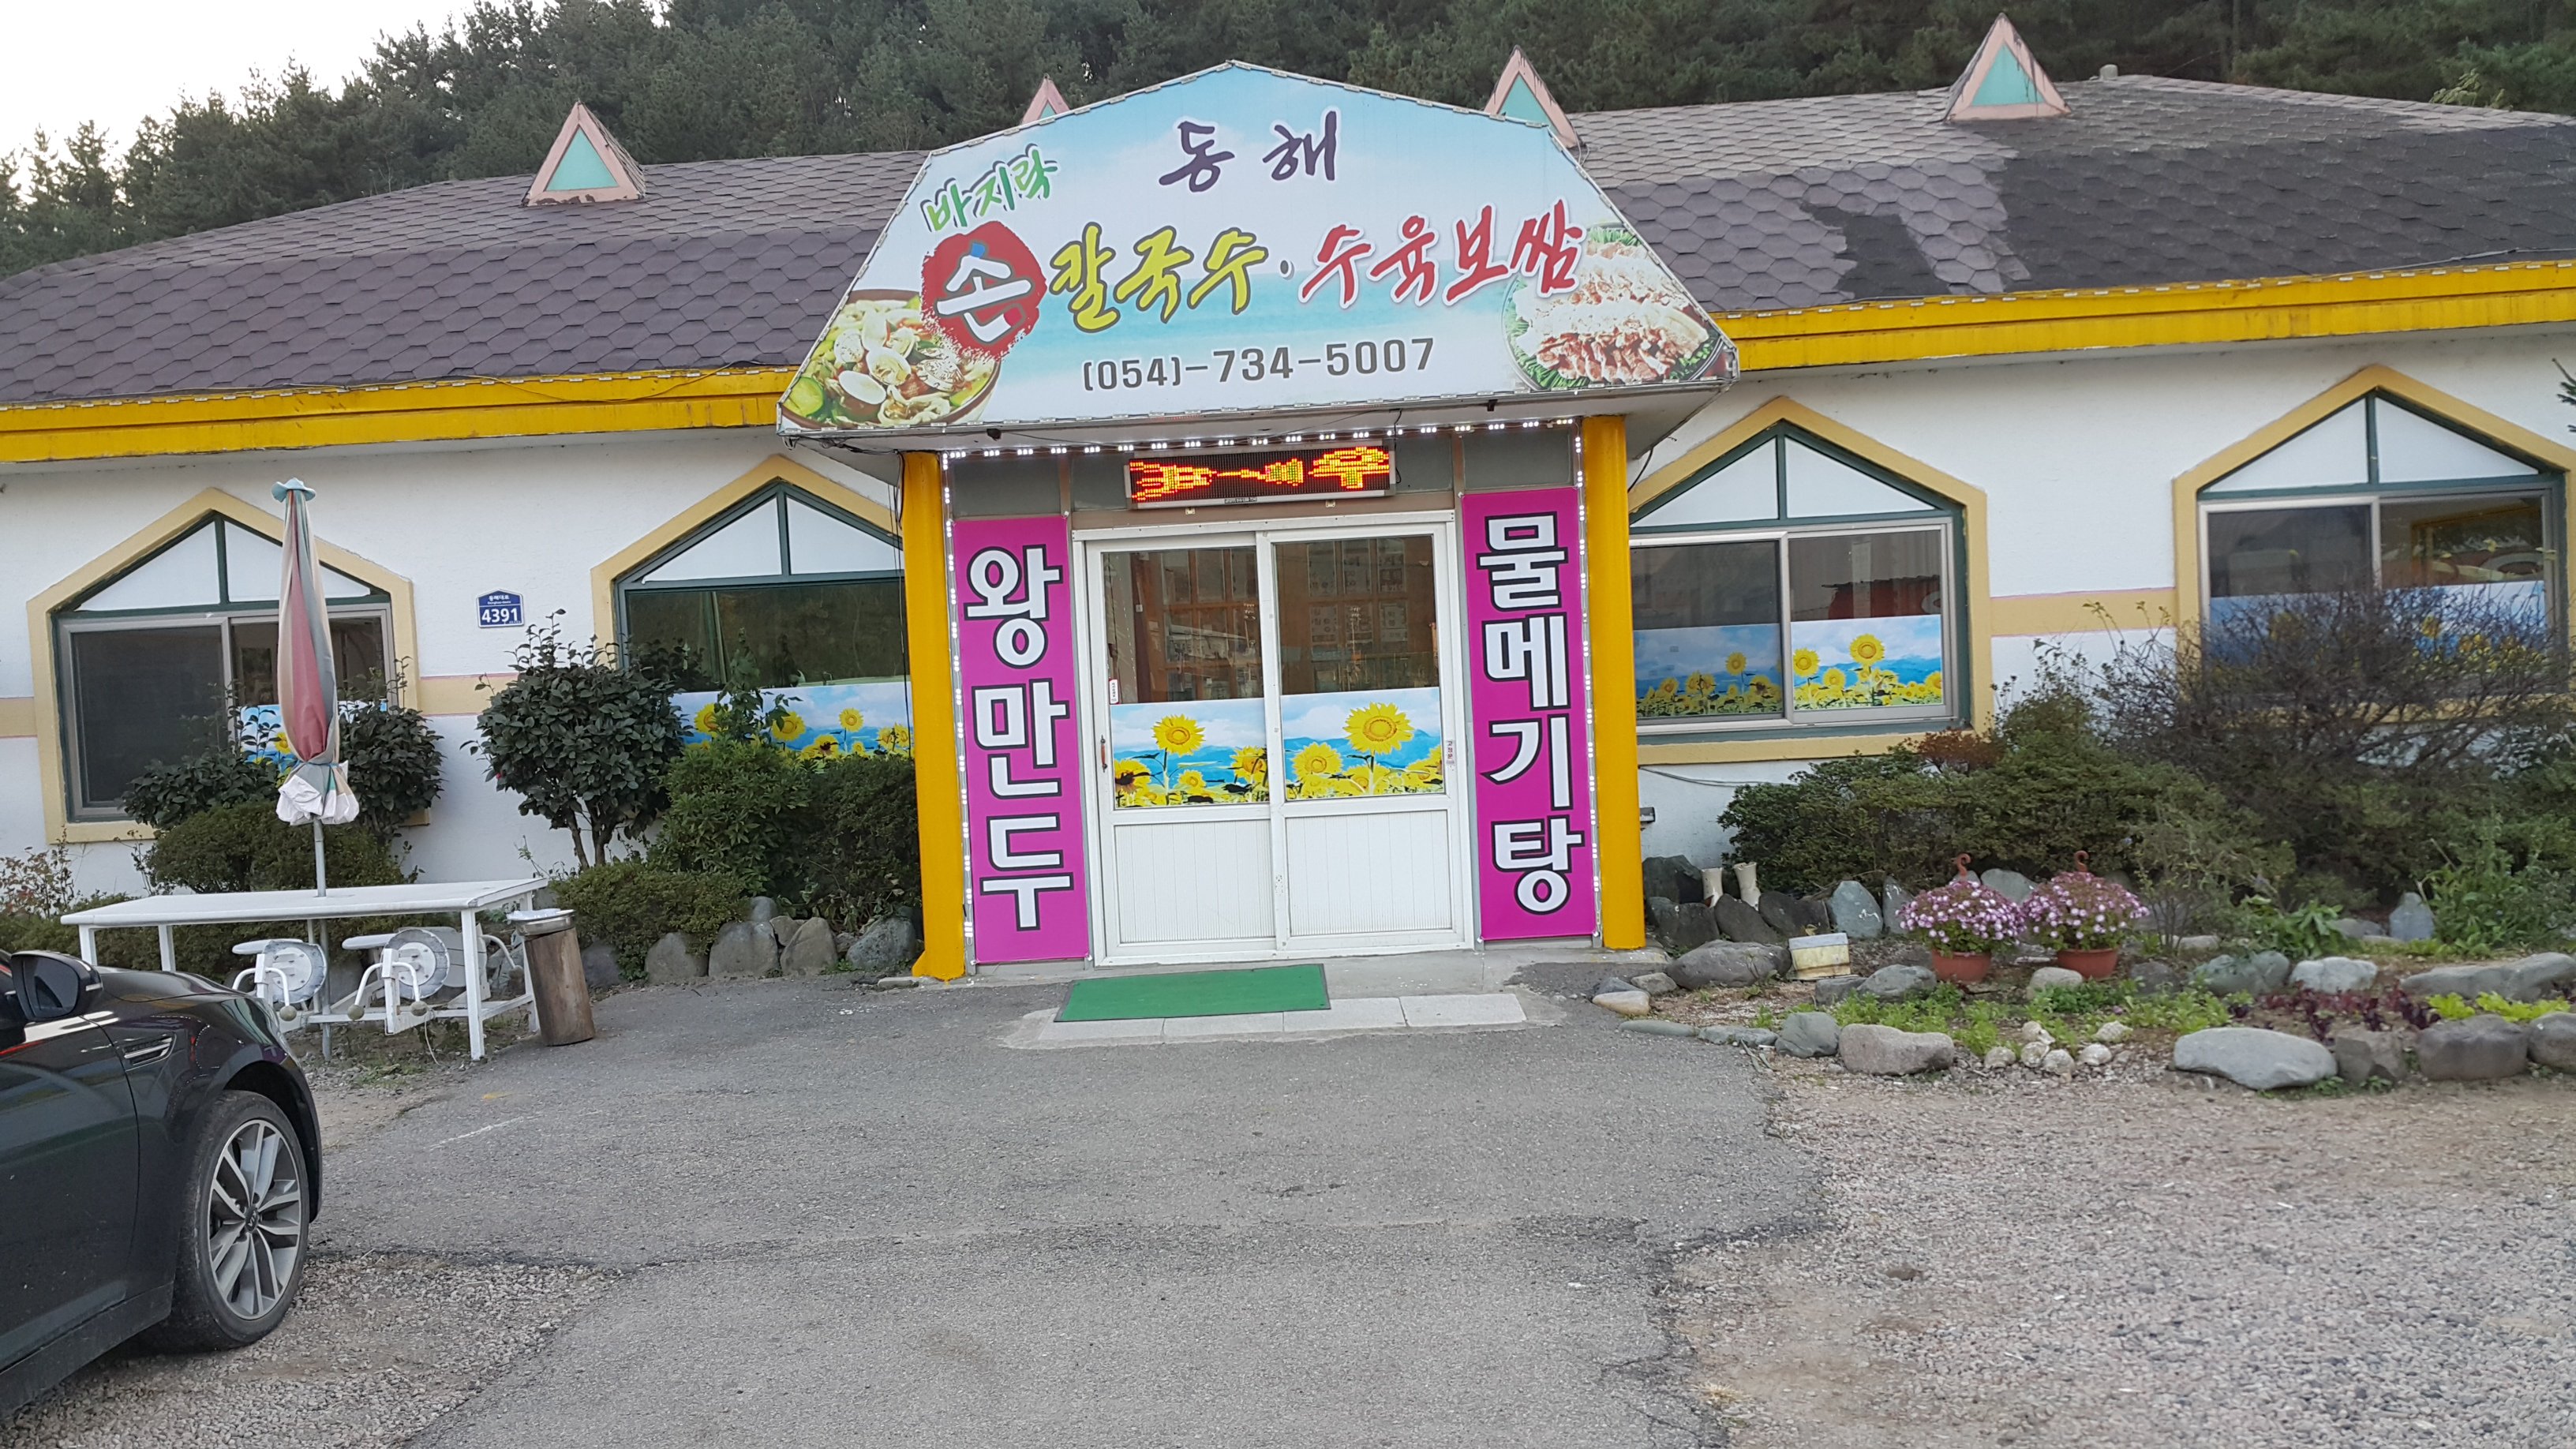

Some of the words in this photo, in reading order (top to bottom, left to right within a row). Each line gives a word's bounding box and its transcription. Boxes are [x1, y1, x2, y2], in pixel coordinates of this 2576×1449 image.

[920, 143, 1058, 232] 바지락
[1050, 222, 1269, 333] 칼국수
[1299, 197, 1586, 306] 수육보쌈
[1082, 337, 1435, 391] (054)-734-5007
[481, 607, 518, 623] 4391
[963, 543, 1074, 932] 왕만두
[1475, 510, 1586, 915] 물메기탕
